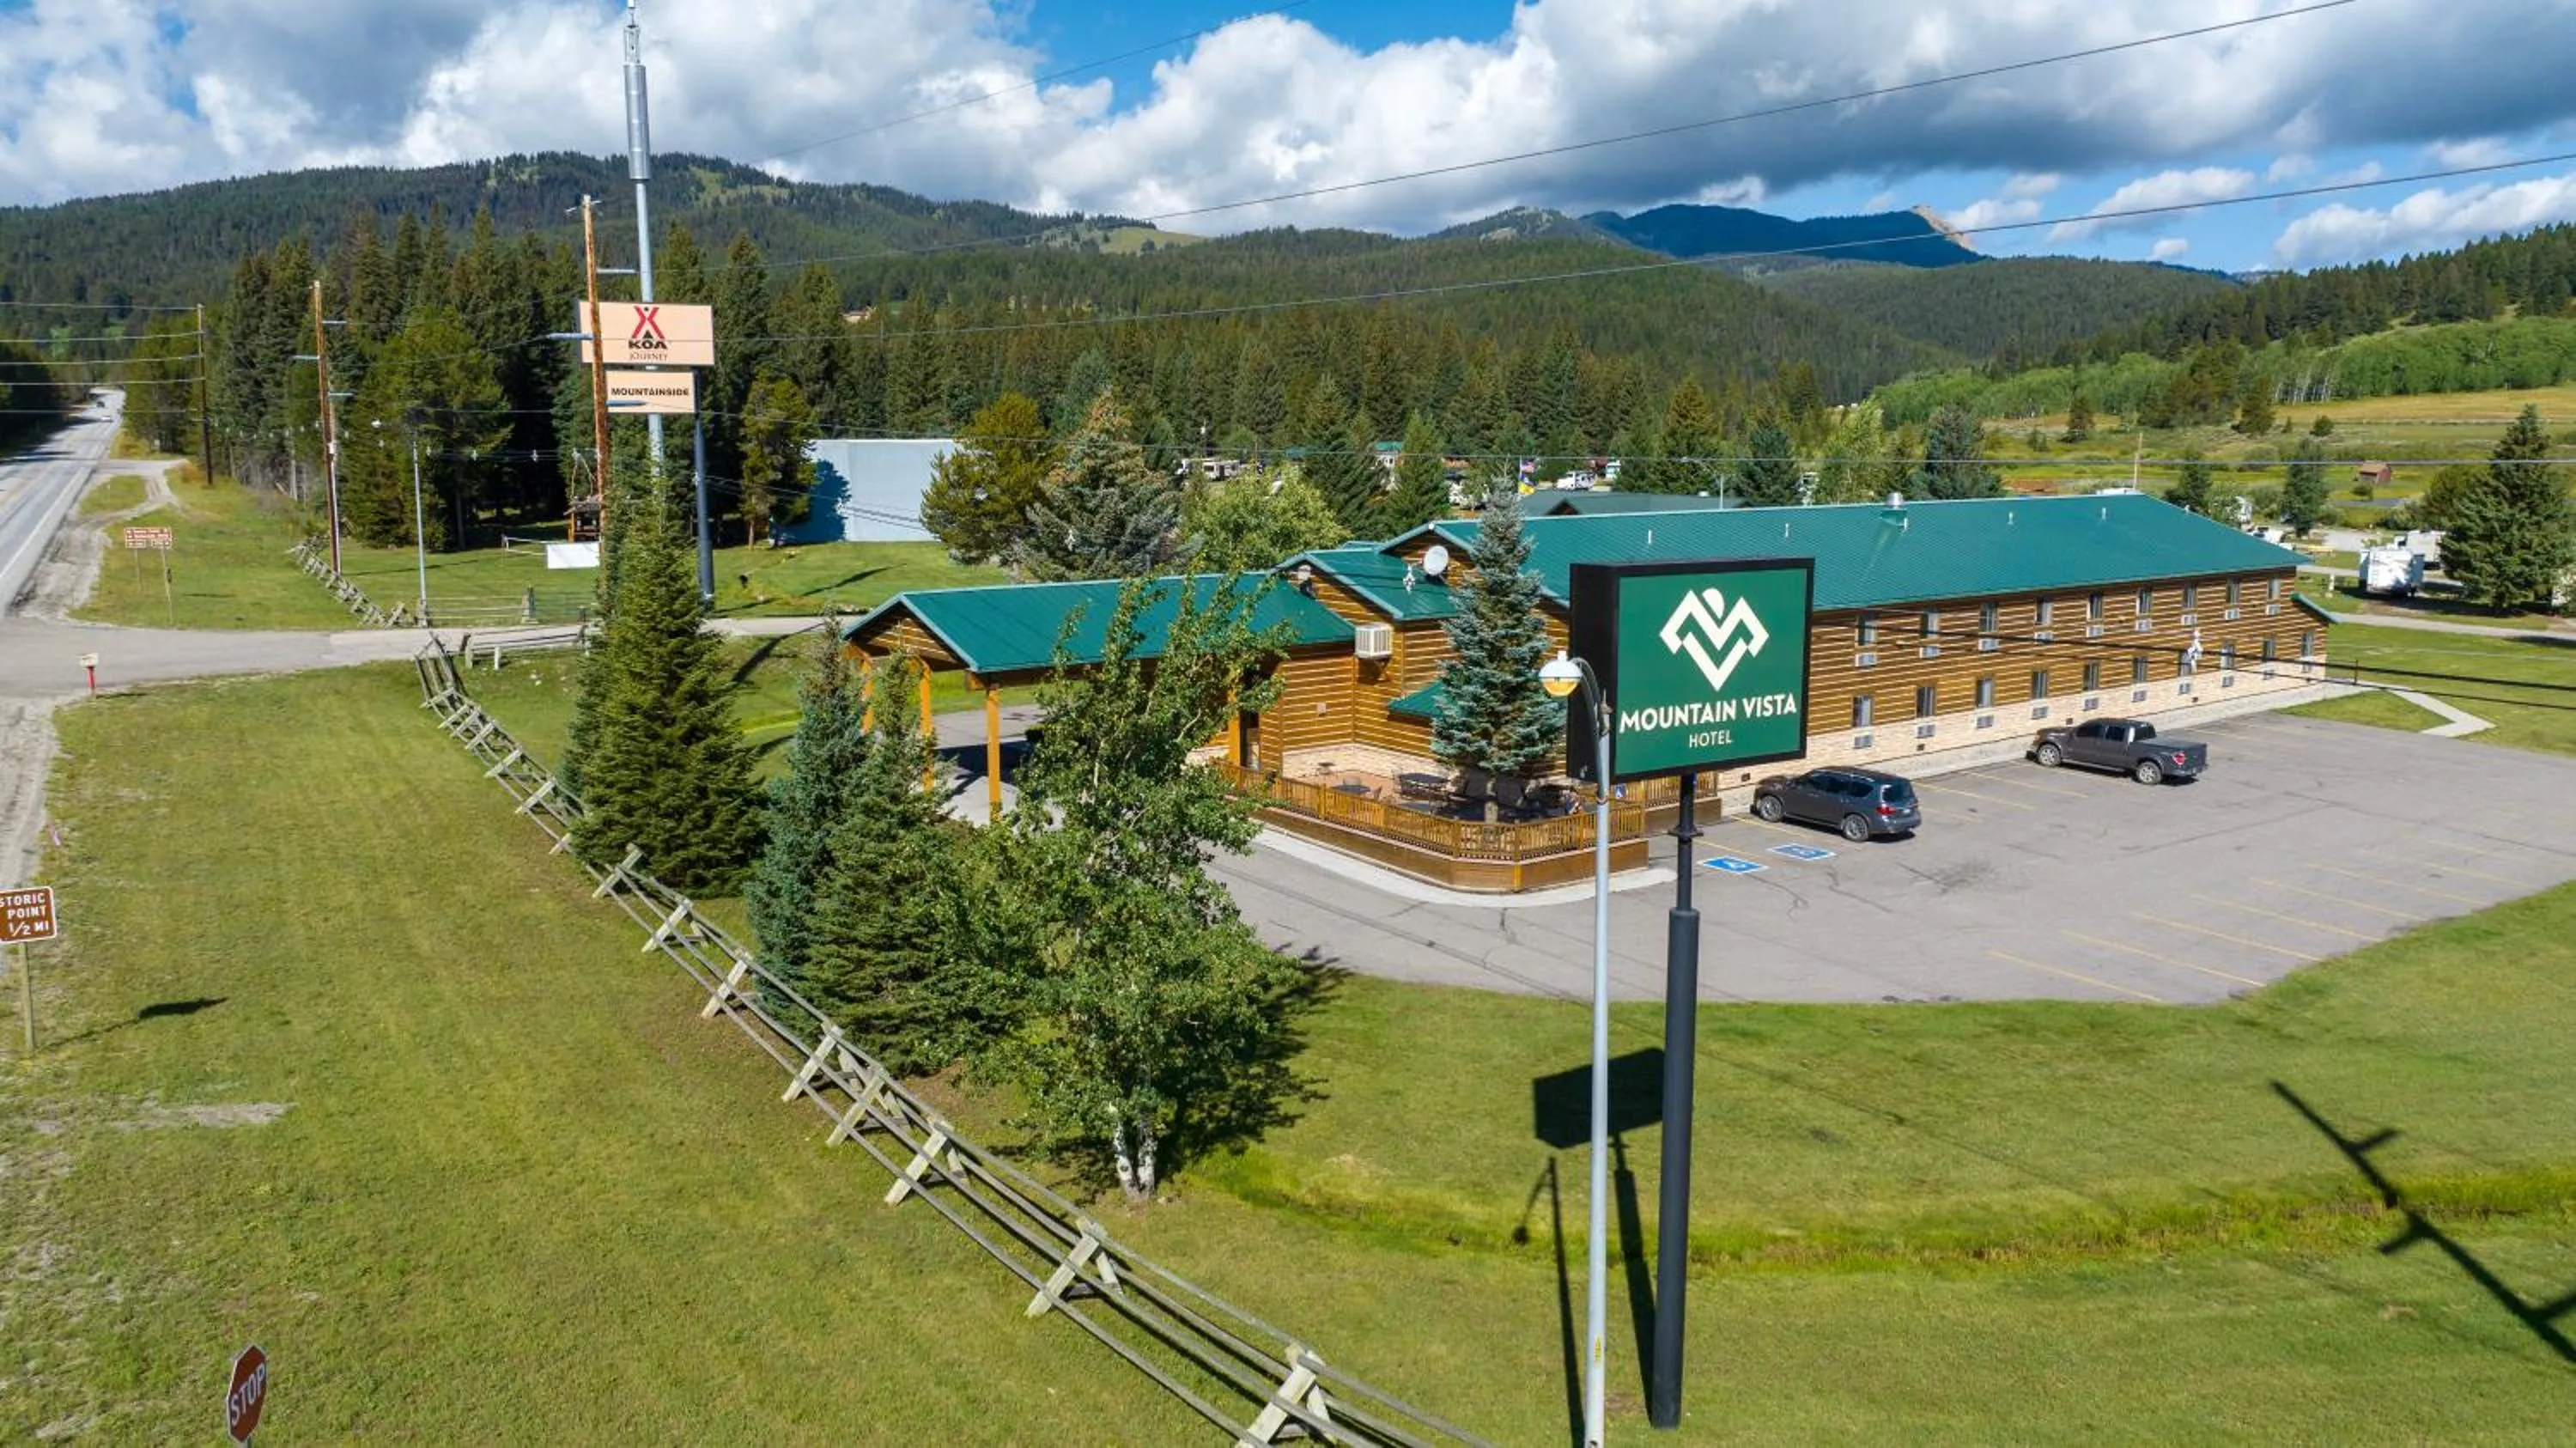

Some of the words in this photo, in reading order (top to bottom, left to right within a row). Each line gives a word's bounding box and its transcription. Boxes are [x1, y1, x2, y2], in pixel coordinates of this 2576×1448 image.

[629, 339, 668, 350] KOA
[611, 387, 690, 396] MOUNTAINSIDE
[1619, 699, 1736, 733] MOUNTAIN
[1741, 693, 1797, 718] VISTA
[1689, 730, 1732, 748] HOTEL
[7, 904, 46, 920] POINT
[9, 921, 31, 937] 1/2
[34, 920, 49, 932] MI
[231, 1363, 265, 1427] STOP
